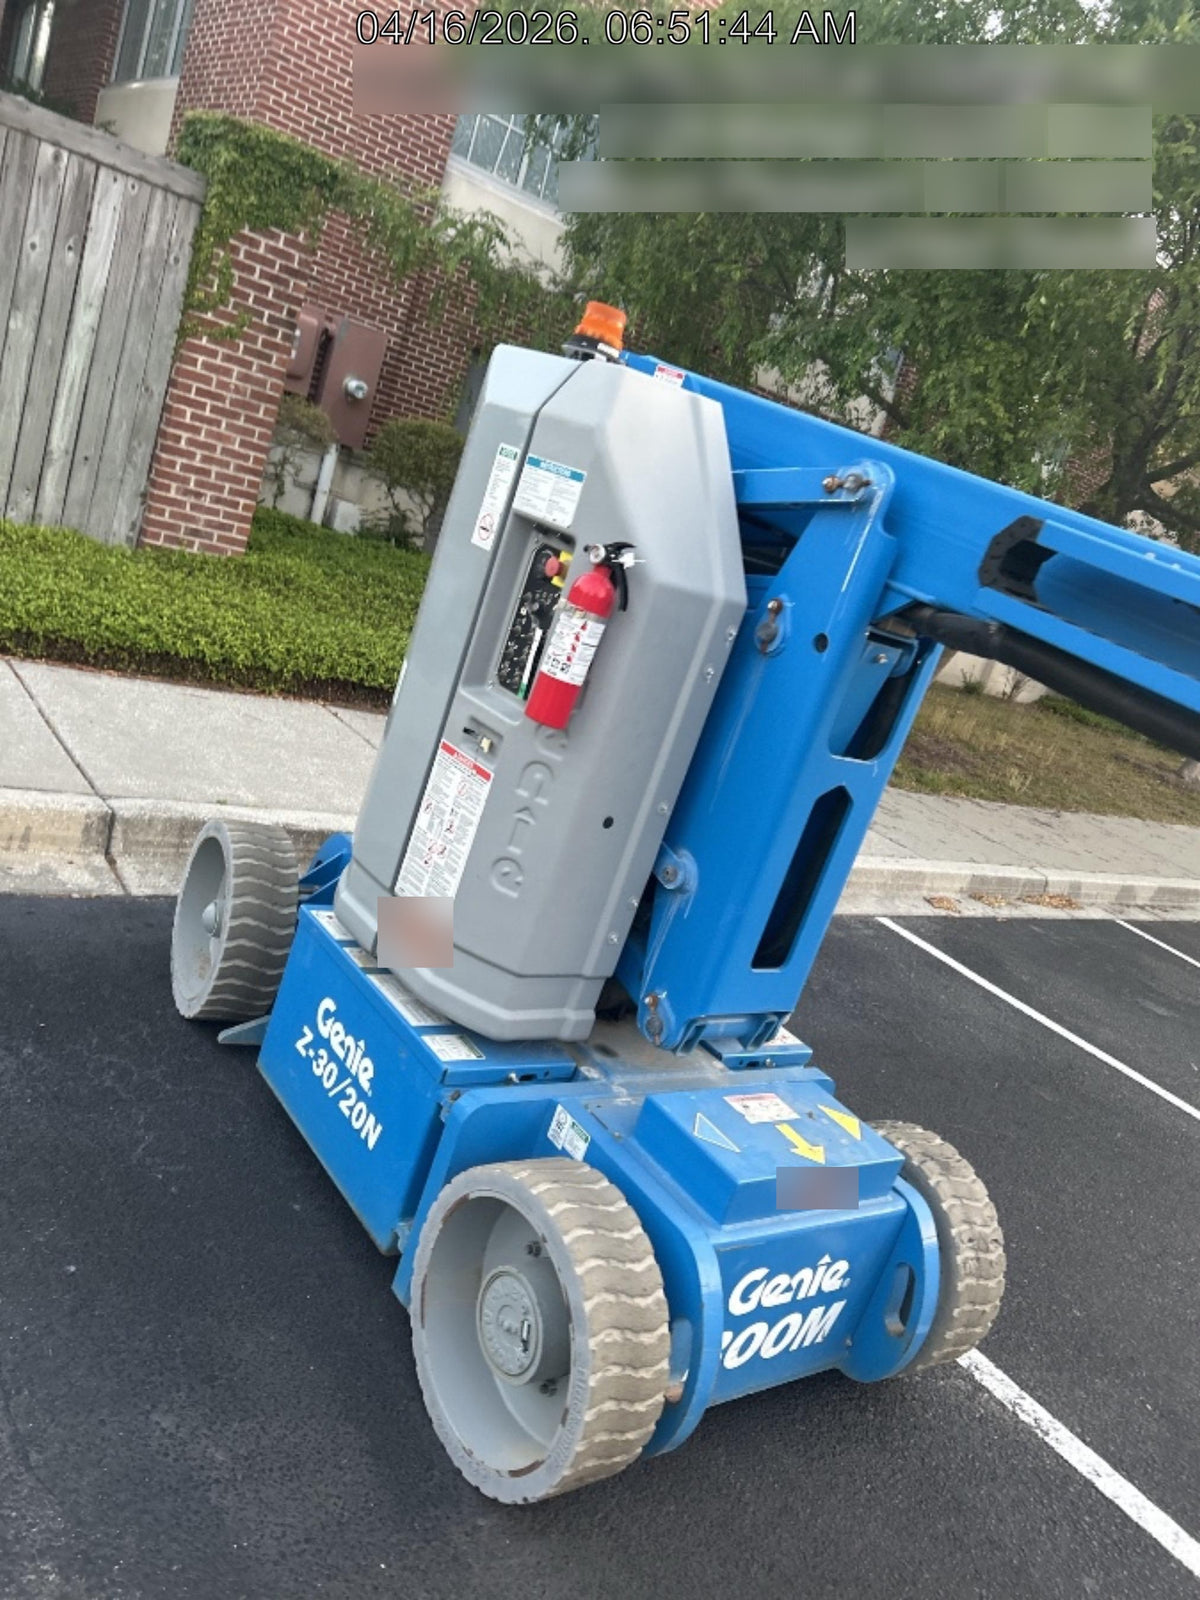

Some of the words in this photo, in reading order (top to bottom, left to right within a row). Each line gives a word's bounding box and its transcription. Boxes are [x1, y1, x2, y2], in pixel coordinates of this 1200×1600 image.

[294, 1024, 384, 1152] Z-30/20N
[316, 996, 375, 1097] Genie
[728, 1252, 851, 1317] Genie
